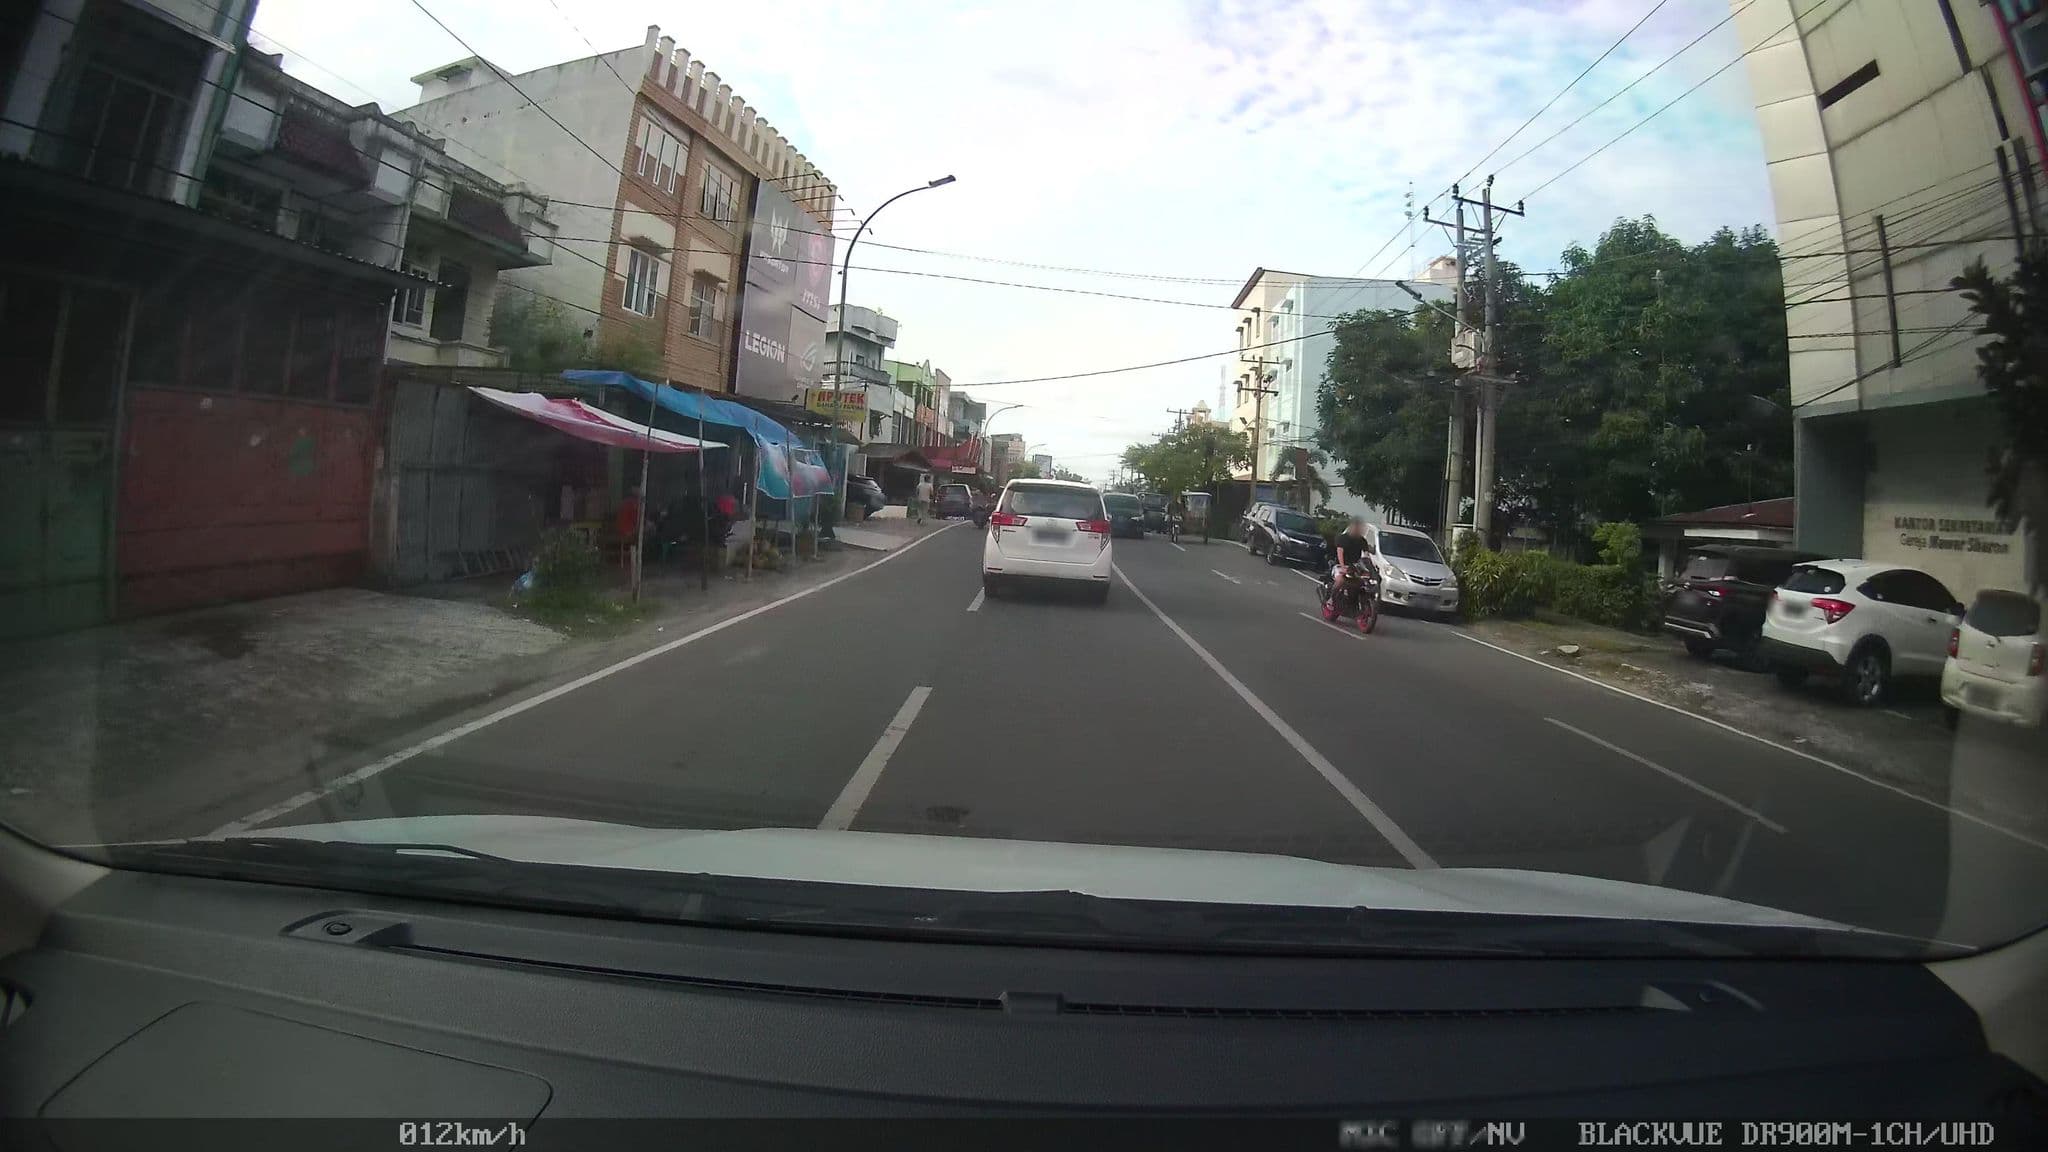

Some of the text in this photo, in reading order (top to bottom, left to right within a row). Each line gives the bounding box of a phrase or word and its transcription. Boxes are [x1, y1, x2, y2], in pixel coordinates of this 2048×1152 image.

[744, 329, 785, 364] LEGION
[817, 391, 865, 405] APTEK
[1894, 516, 1935, 531] KANTOR
